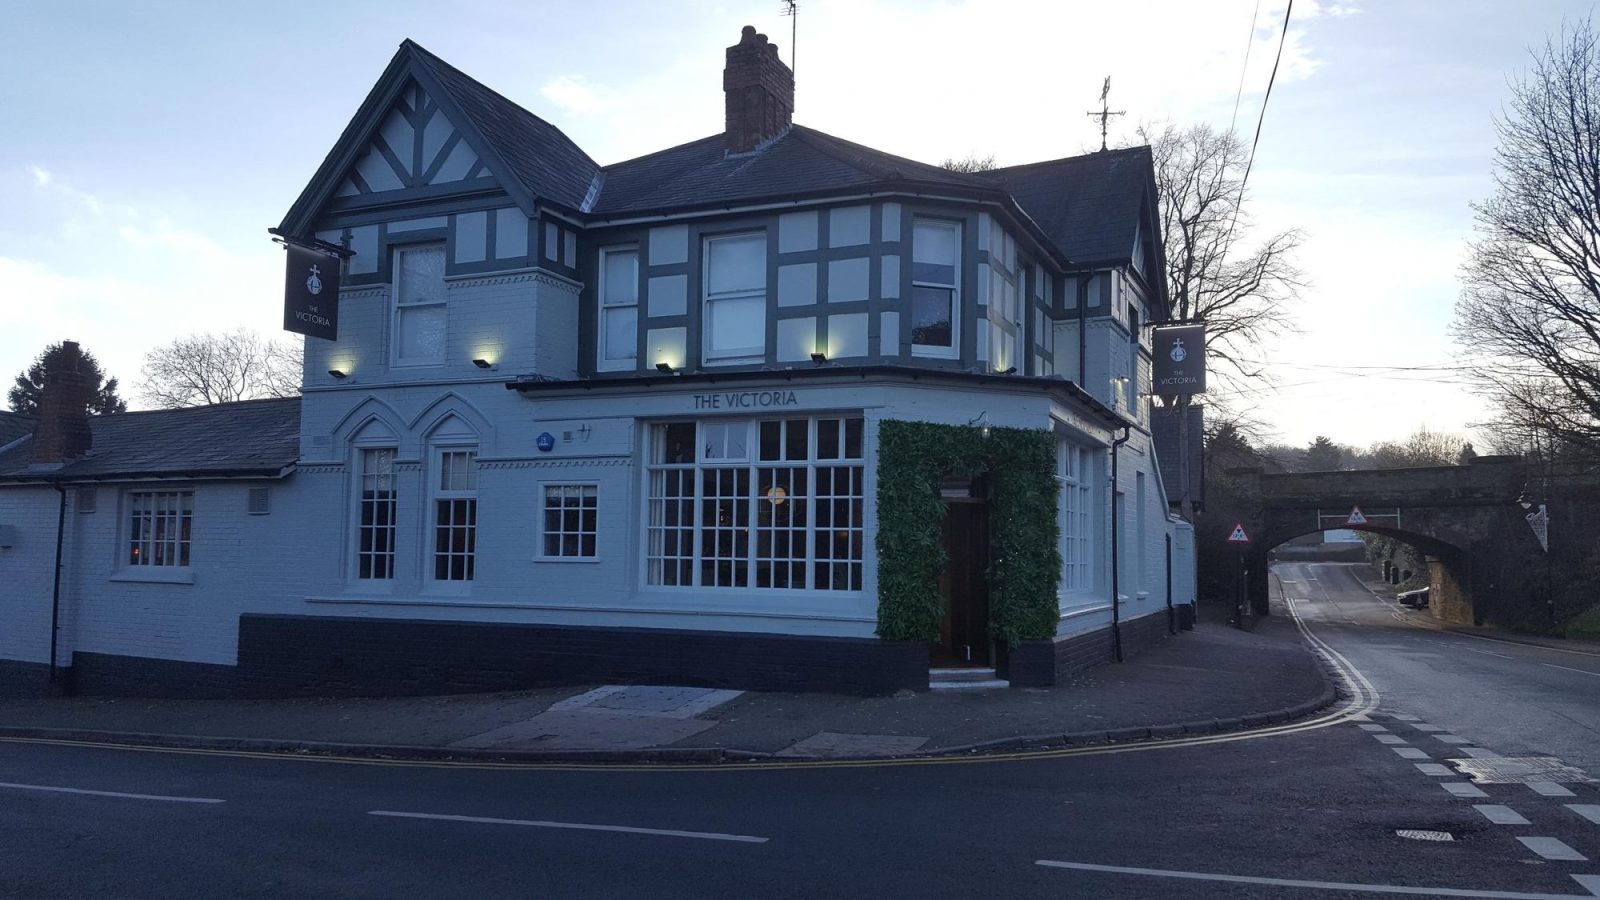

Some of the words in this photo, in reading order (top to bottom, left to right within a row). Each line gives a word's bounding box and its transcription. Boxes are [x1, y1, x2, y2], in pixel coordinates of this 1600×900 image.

[295, 311, 330, 327] VICTORIA
[1160, 376, 1197, 385] VICTORIA
[693, 395, 720, 409] THE
[725, 391, 798, 408] VICTORIA
